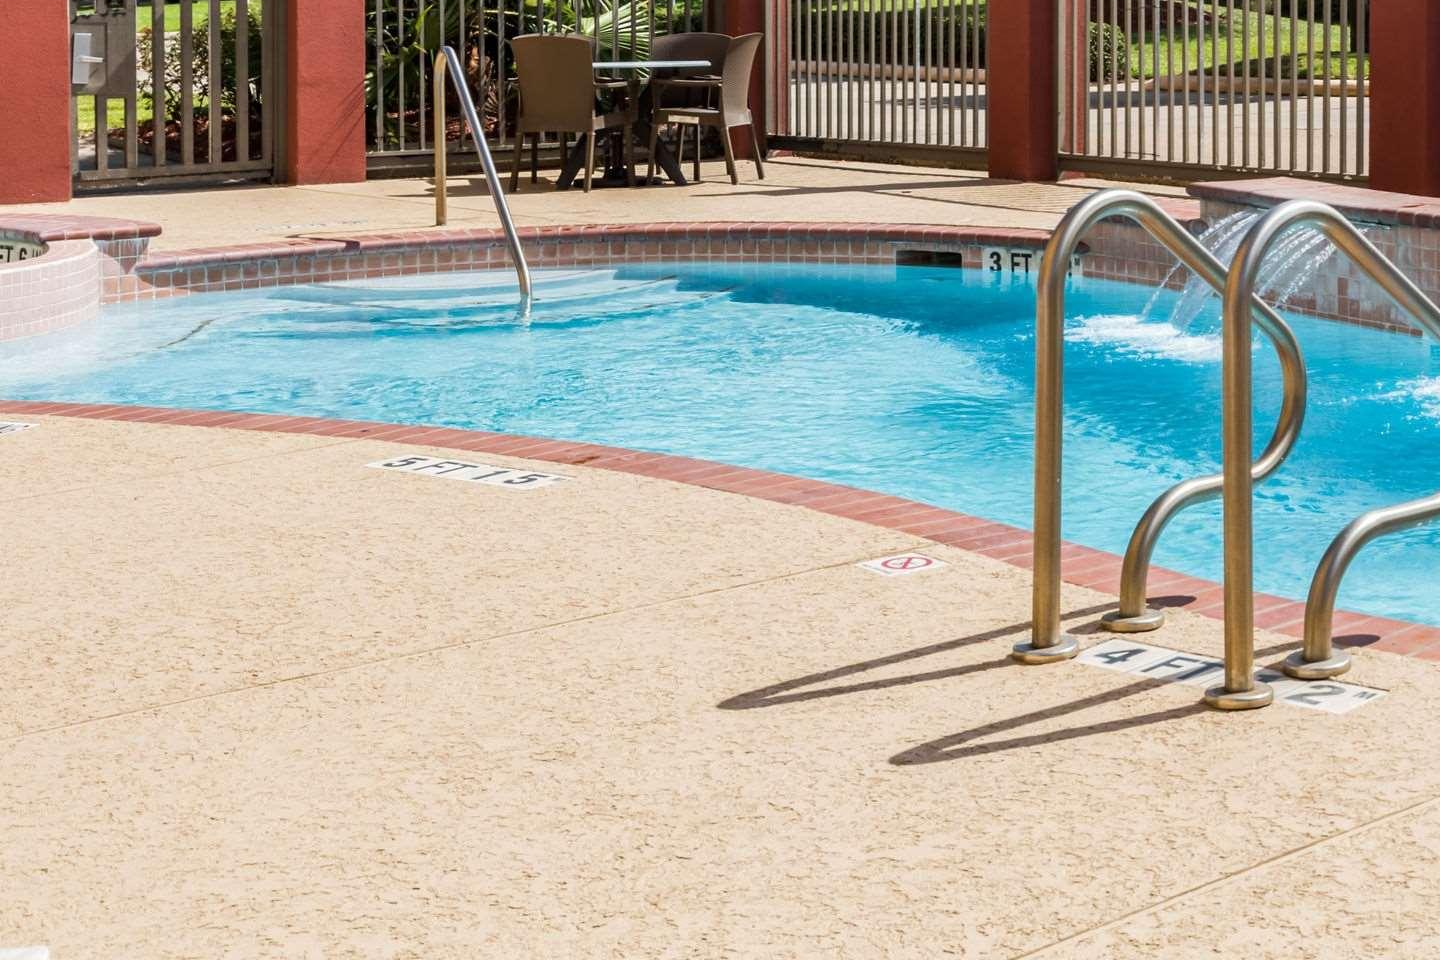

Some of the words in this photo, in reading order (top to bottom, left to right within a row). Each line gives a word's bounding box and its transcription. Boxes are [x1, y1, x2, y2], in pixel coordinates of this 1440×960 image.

[989, 251, 1002, 272] 3
[1010, 252, 1033, 273] FT
[383, 457, 429, 468] 5
[414, 461, 479, 475] FT
[1093, 648, 1148, 664] 4
[1140, 656, 1225, 681] FT
